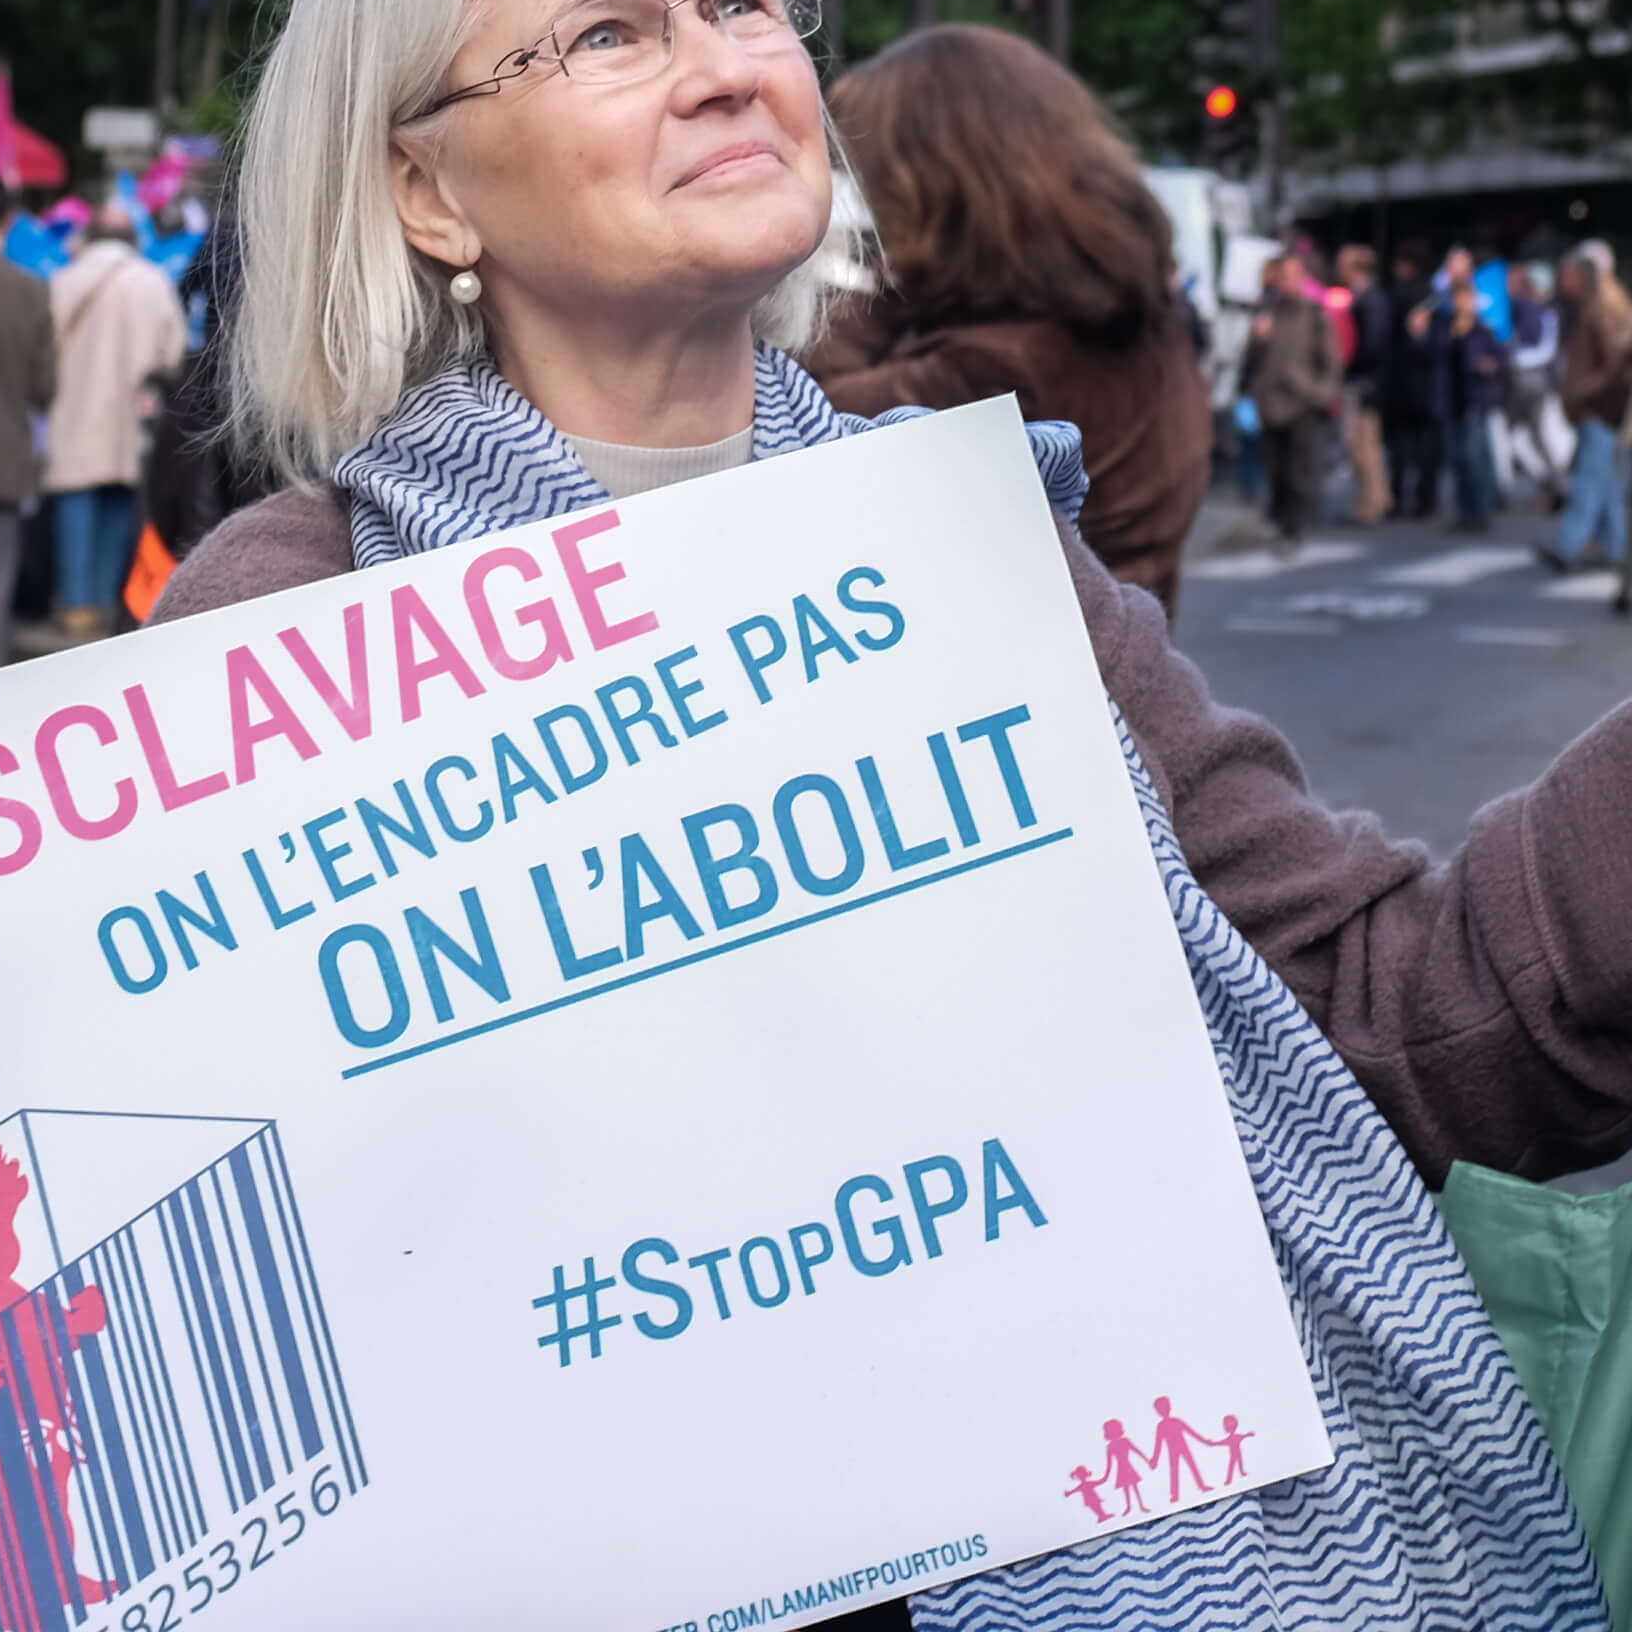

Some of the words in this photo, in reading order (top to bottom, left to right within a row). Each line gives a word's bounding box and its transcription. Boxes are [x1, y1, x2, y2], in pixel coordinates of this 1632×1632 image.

[96, 870, 240, 997] ON
[241, 644, 730, 932] L'ENCADRE
[737, 564, 909, 706] PAS
[316, 886, 514, 1052] ON
[526, 703, 1041, 984] L'ABOLIT
[98, 1463, 342, 1632] 8253256
